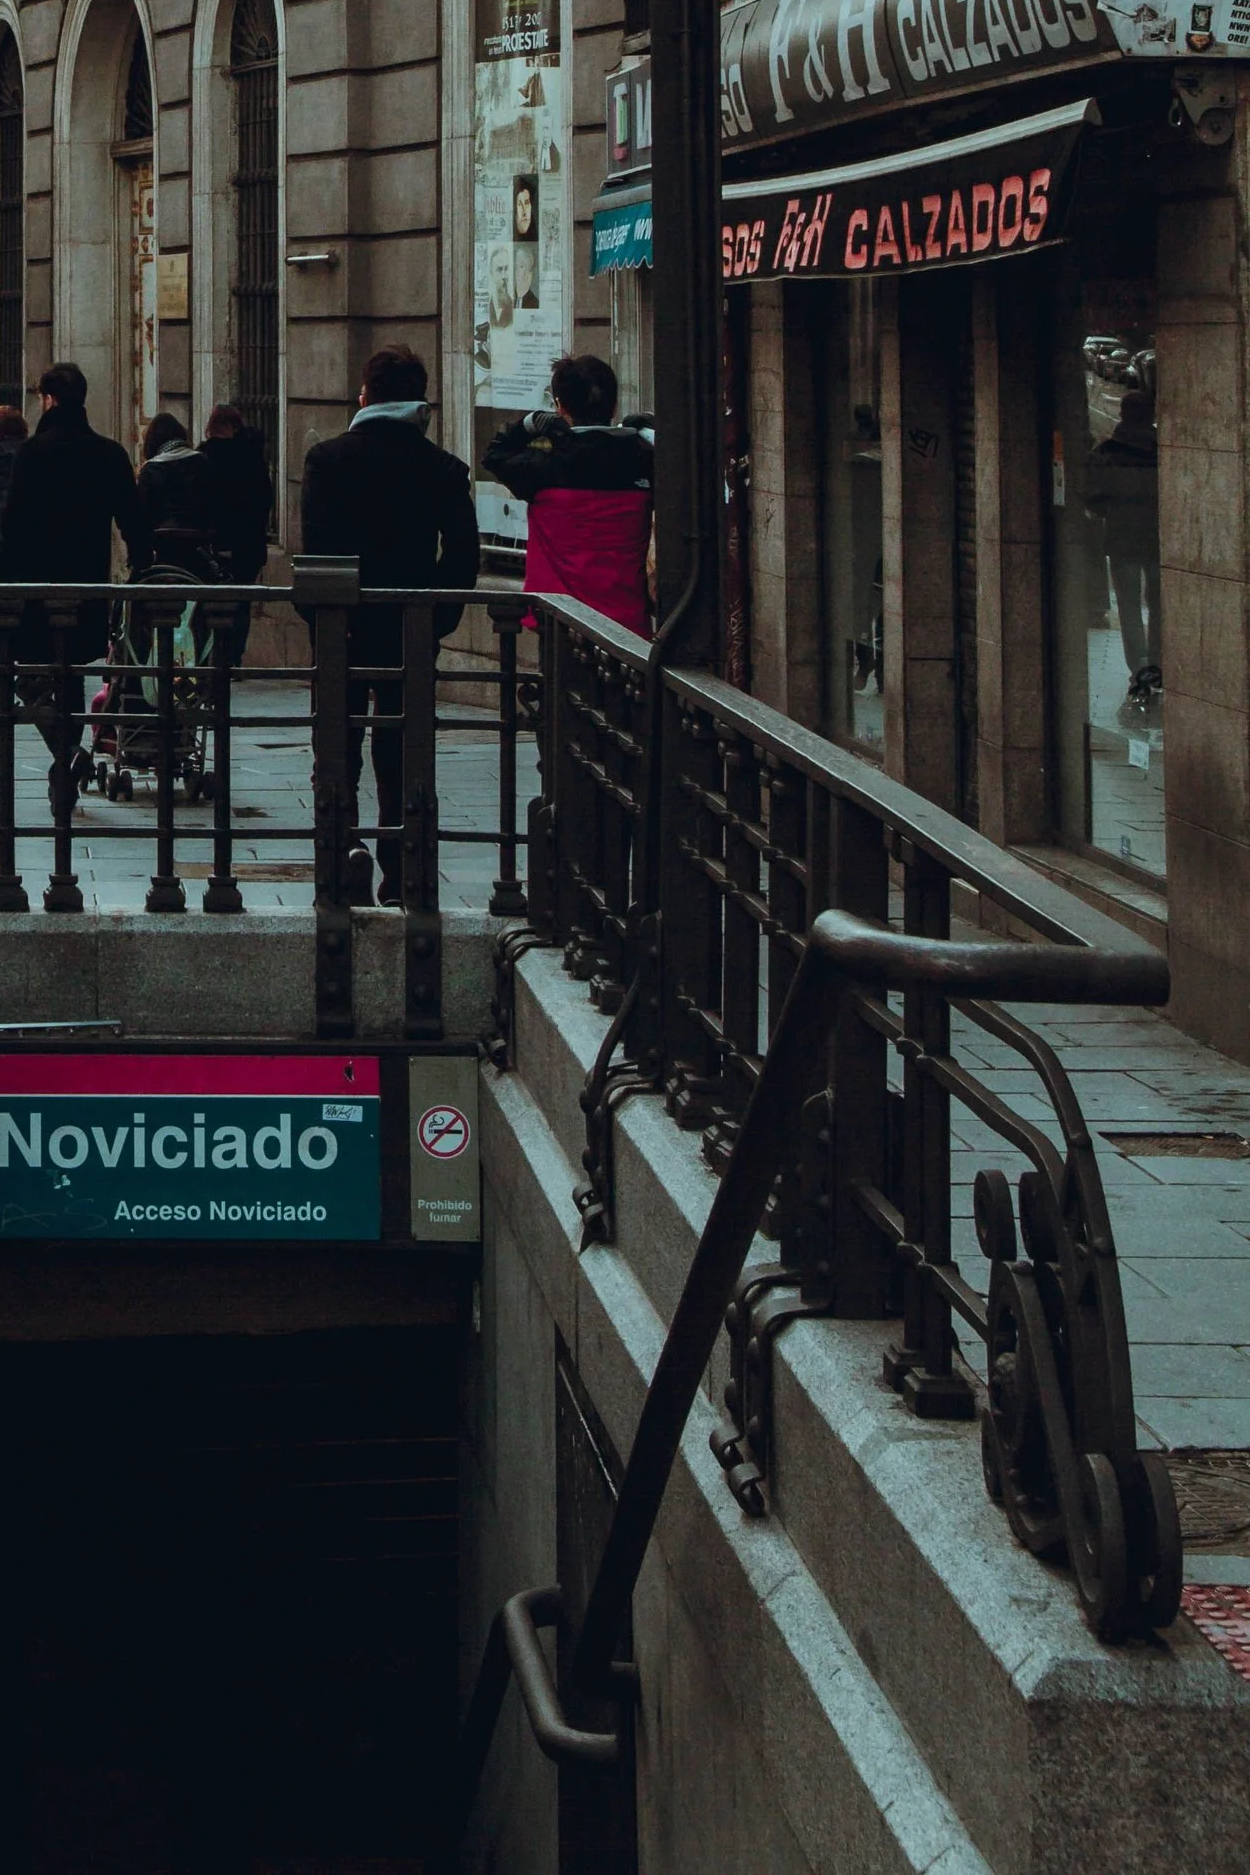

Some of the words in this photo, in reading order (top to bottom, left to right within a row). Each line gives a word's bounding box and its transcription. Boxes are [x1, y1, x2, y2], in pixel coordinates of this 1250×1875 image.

[844, 168, 1051, 270] CALZADOS
[114, 1200, 202, 1222] Acceso
[209, 1200, 328, 1222] Noviciado
[417, 1199, 473, 1211] Prohibido
[429, 1212, 462, 1223] fumar
